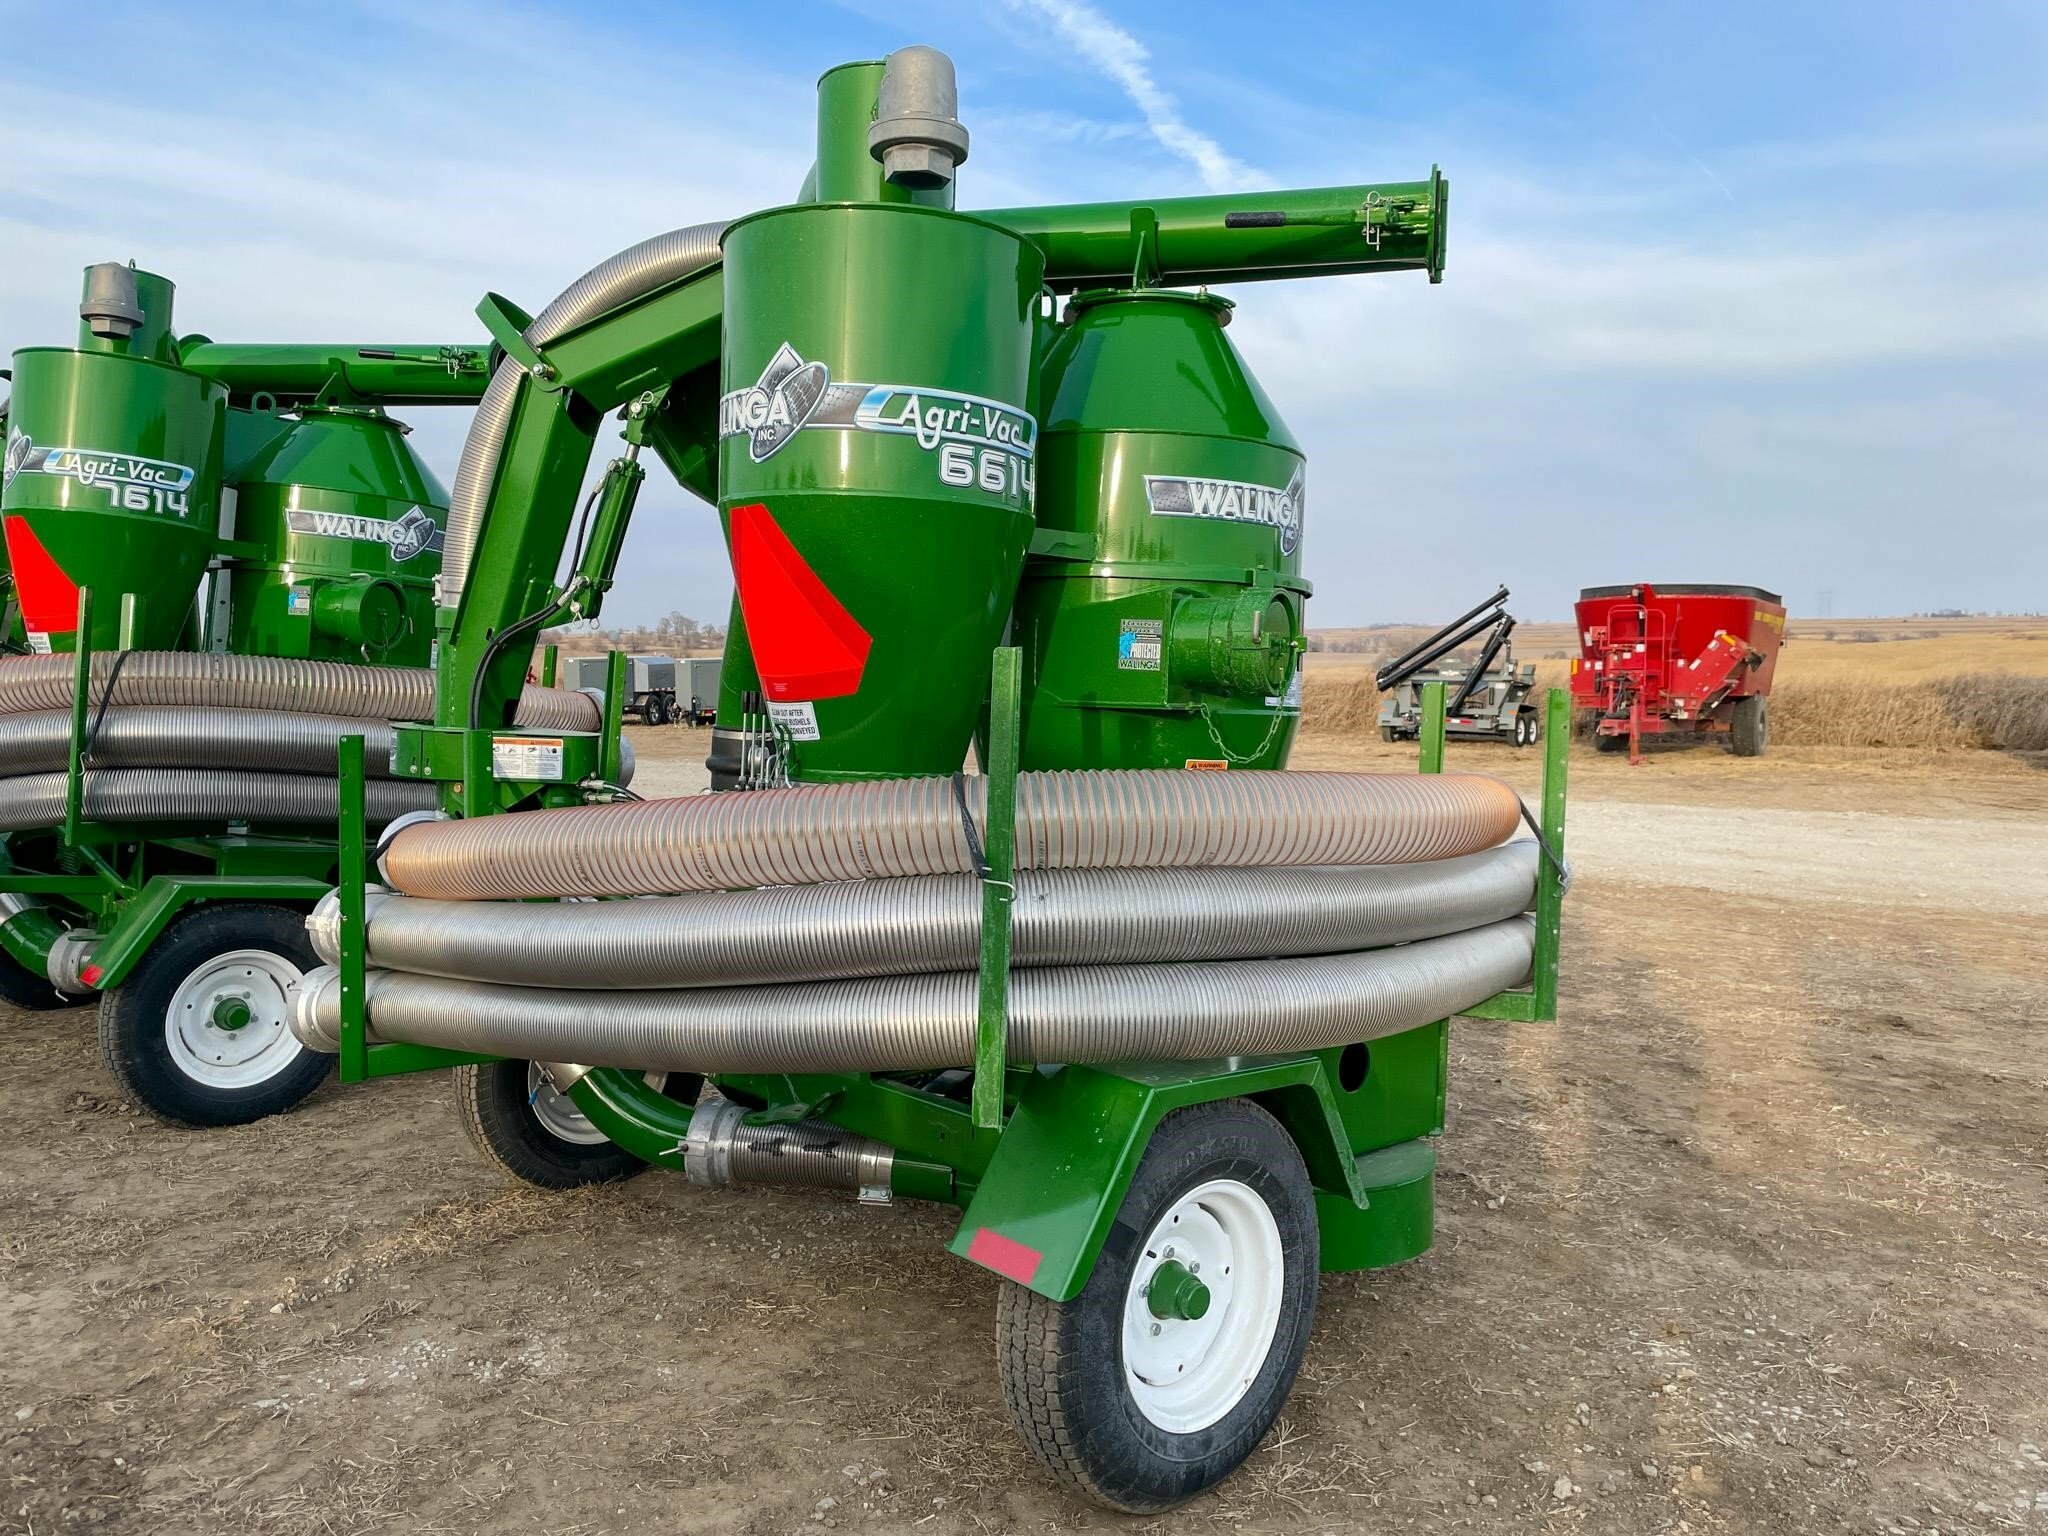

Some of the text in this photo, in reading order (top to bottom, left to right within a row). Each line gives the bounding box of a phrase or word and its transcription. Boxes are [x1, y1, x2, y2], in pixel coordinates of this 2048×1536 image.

[721, 388, 793, 434] LINGA
[899, 394, 1021, 450] Agri-Vac
[758, 428, 777, 441] INC.
[68, 453, 166, 485] Agri-Vac
[939, 443, 1034, 502] 6614
[93, 480, 189, 518] 7614
[1188, 481, 1299, 528] WALINGA
[314, 514, 419, 547] WALINGA
[1120, 659, 1159, 669] WALINGA
